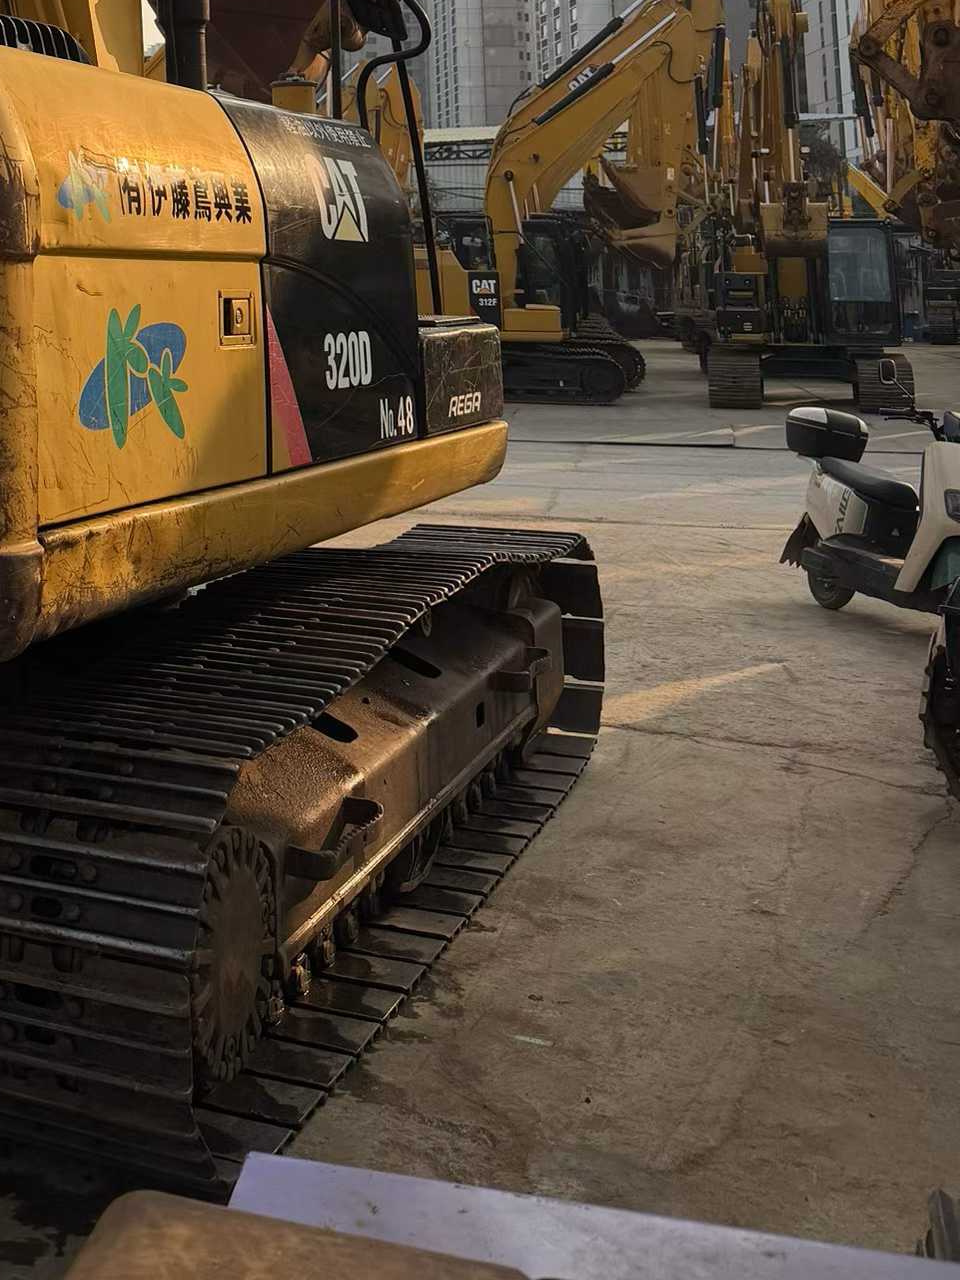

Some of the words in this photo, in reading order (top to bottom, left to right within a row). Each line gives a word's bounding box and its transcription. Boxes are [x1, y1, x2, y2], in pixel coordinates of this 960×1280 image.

[304, 153, 368, 242] CAT
[471, 279, 496, 294] CAT
[478, 298, 498, 306] 312F
[323, 330, 373, 391] 320D
[379, 395, 414, 439] No.48
[448, 391, 482, 418] REGA
